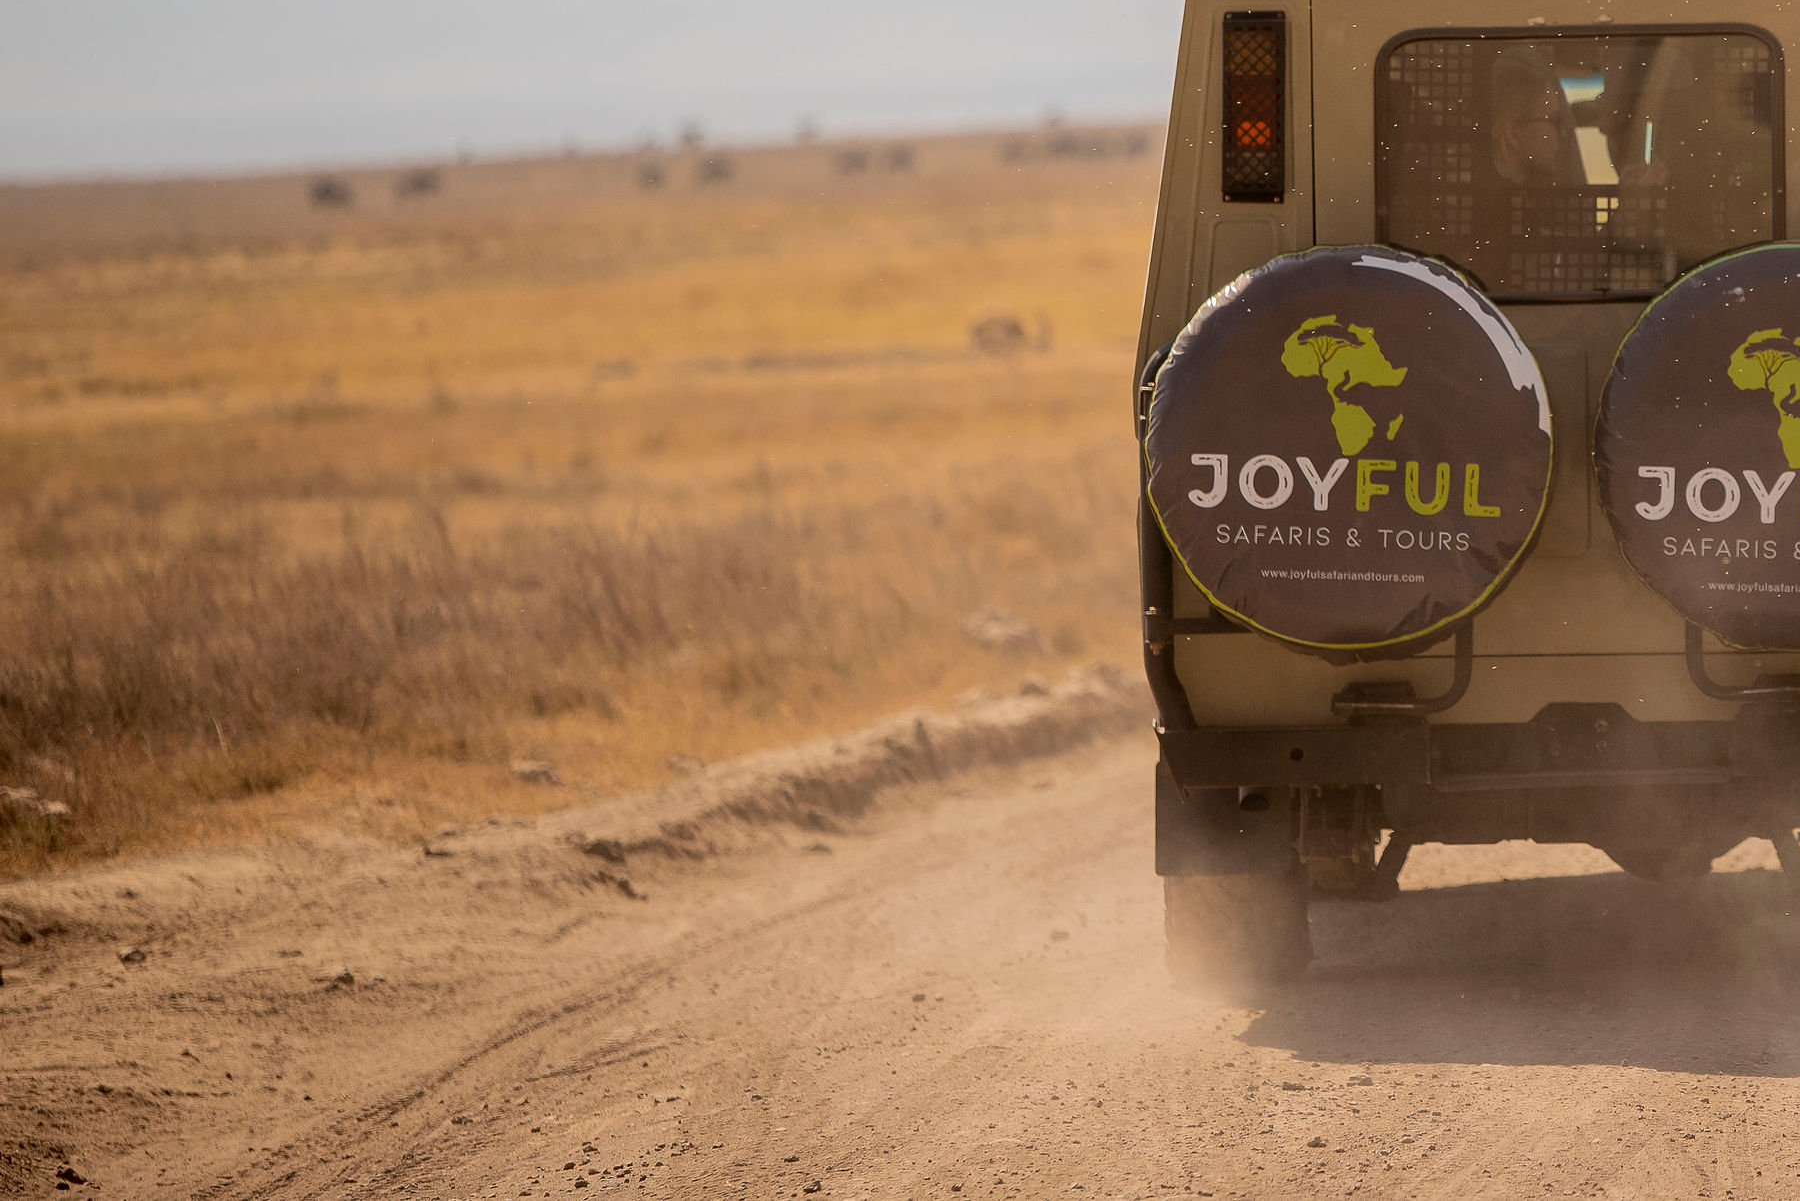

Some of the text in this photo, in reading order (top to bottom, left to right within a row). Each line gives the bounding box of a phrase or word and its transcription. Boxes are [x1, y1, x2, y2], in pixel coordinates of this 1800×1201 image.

[1187, 453, 1502, 518] JOYFUL
[1215, 523, 1470, 552] SAFARIS & TOURS
[1662, 536, 1778, 560] SAFARIS
[1260, 568, 1426, 584] www.joyfulsafariandtours.com
